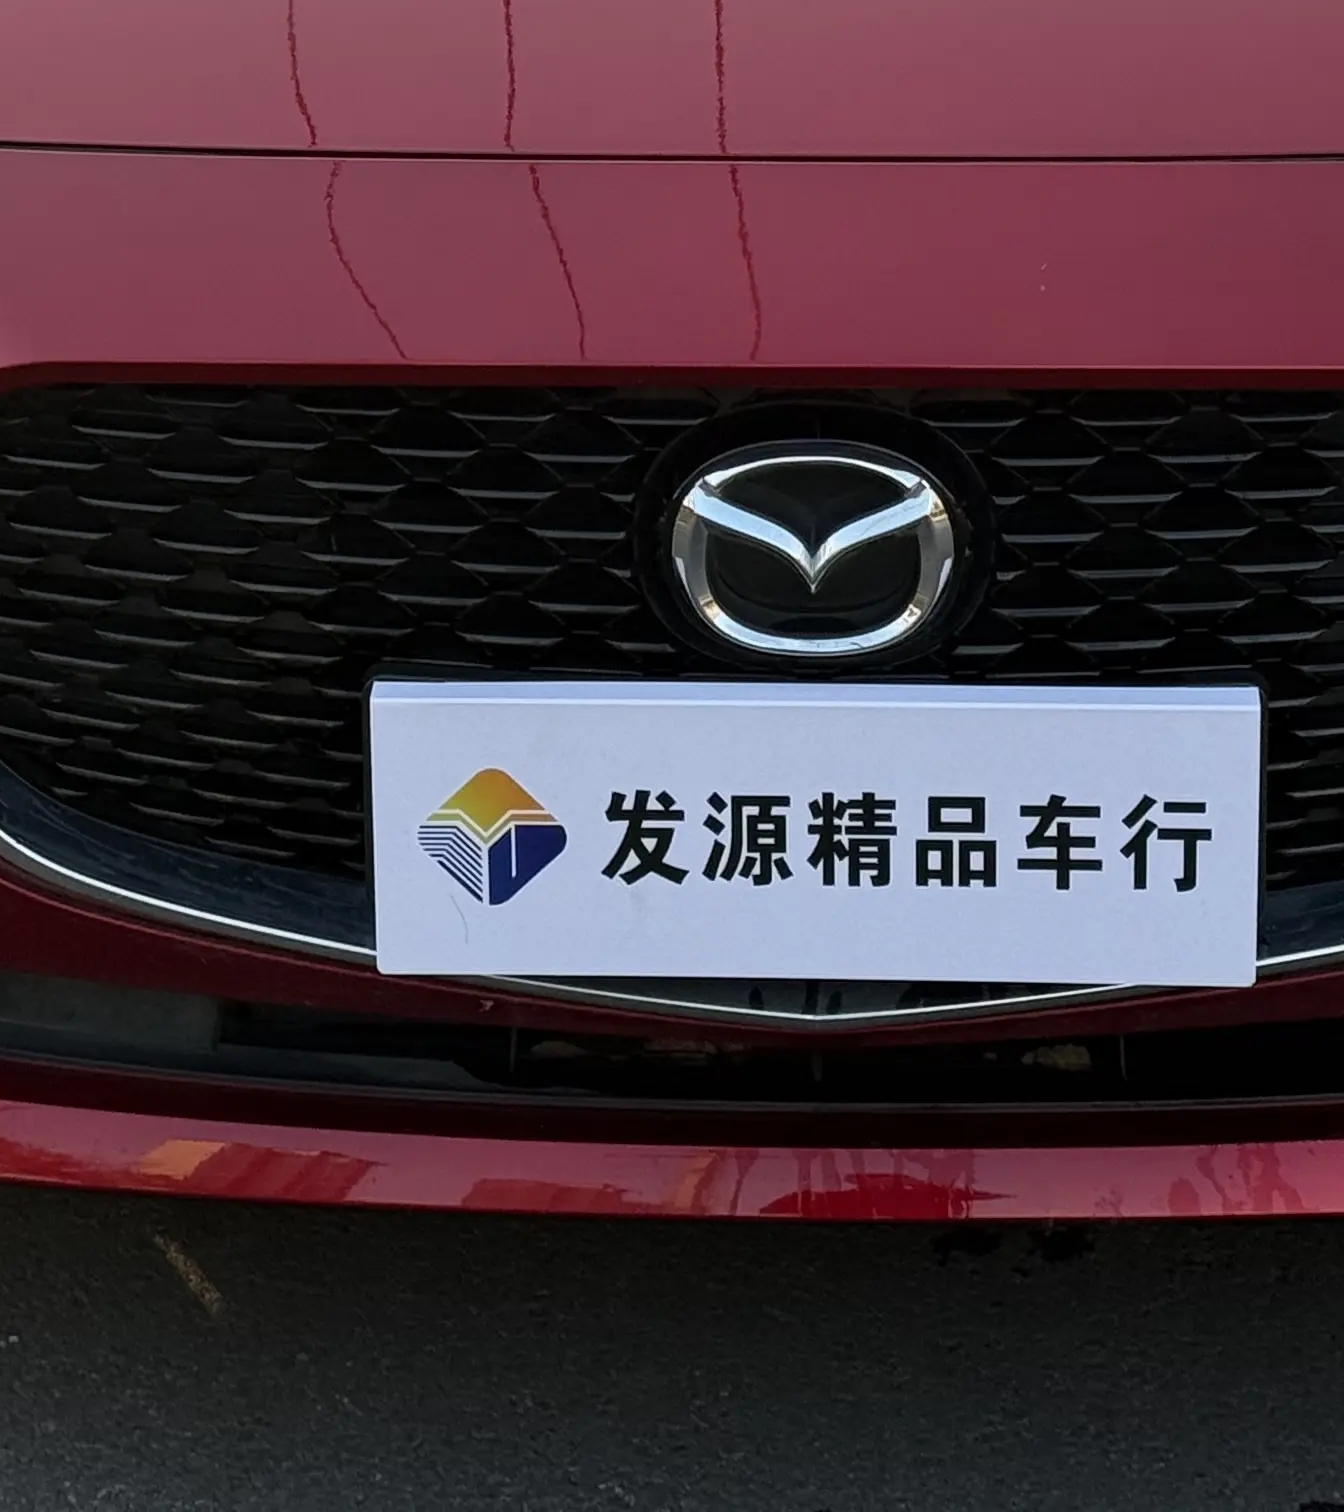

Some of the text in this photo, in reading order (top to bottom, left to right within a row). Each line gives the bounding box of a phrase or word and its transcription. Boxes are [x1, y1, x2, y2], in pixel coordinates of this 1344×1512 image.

[600, 789, 1213, 893] 发源精品车行
